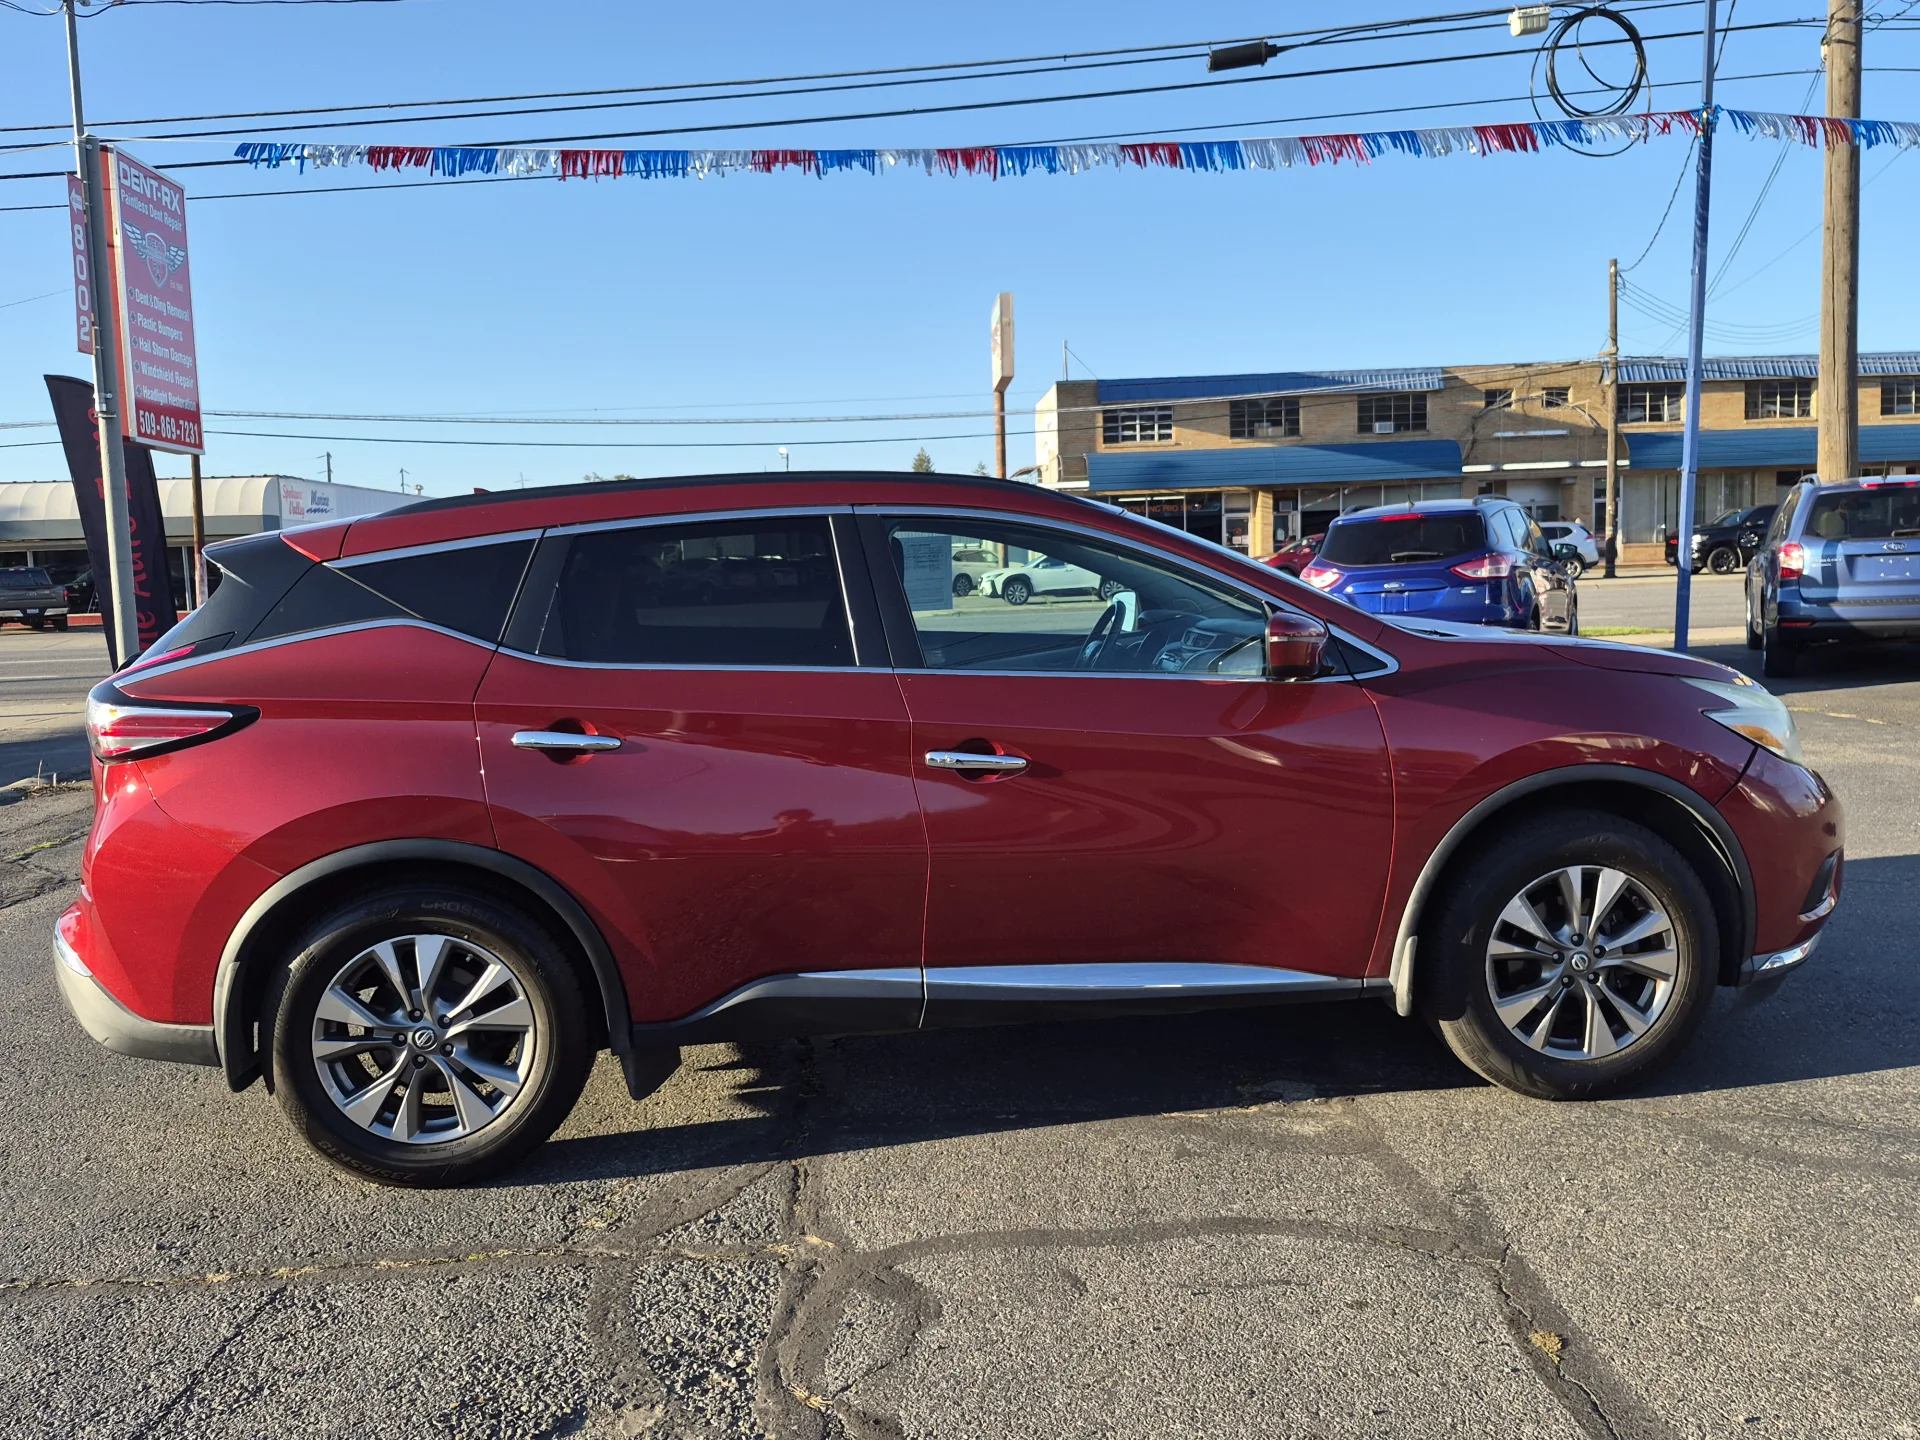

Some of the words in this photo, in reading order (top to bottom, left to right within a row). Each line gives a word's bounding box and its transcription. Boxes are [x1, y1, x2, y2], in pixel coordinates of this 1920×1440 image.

[119, 161, 182, 215] DENT-RX
[121, 189, 149, 216] Paintless
[149, 204, 164, 222] Dent
[164, 212, 183, 232] Repair
[135, 288, 149, 306] Dent
[153, 296, 167, 316] Ding
[166, 301, 190, 322] Removal
[137, 313, 157, 332] Plastic
[158, 320, 183, 342] Bumpers
[139, 337, 151, 353] Hail
[152, 341, 170, 359] Storm
[170, 348, 193, 368] Damage
[141, 361, 174, 383] Windshield
[175, 371, 194, 389] Repair
[143, 385, 168, 406] Headlight
[168, 391, 197, 411] Restoration
[139, 409, 199, 445] 509-869-7231
